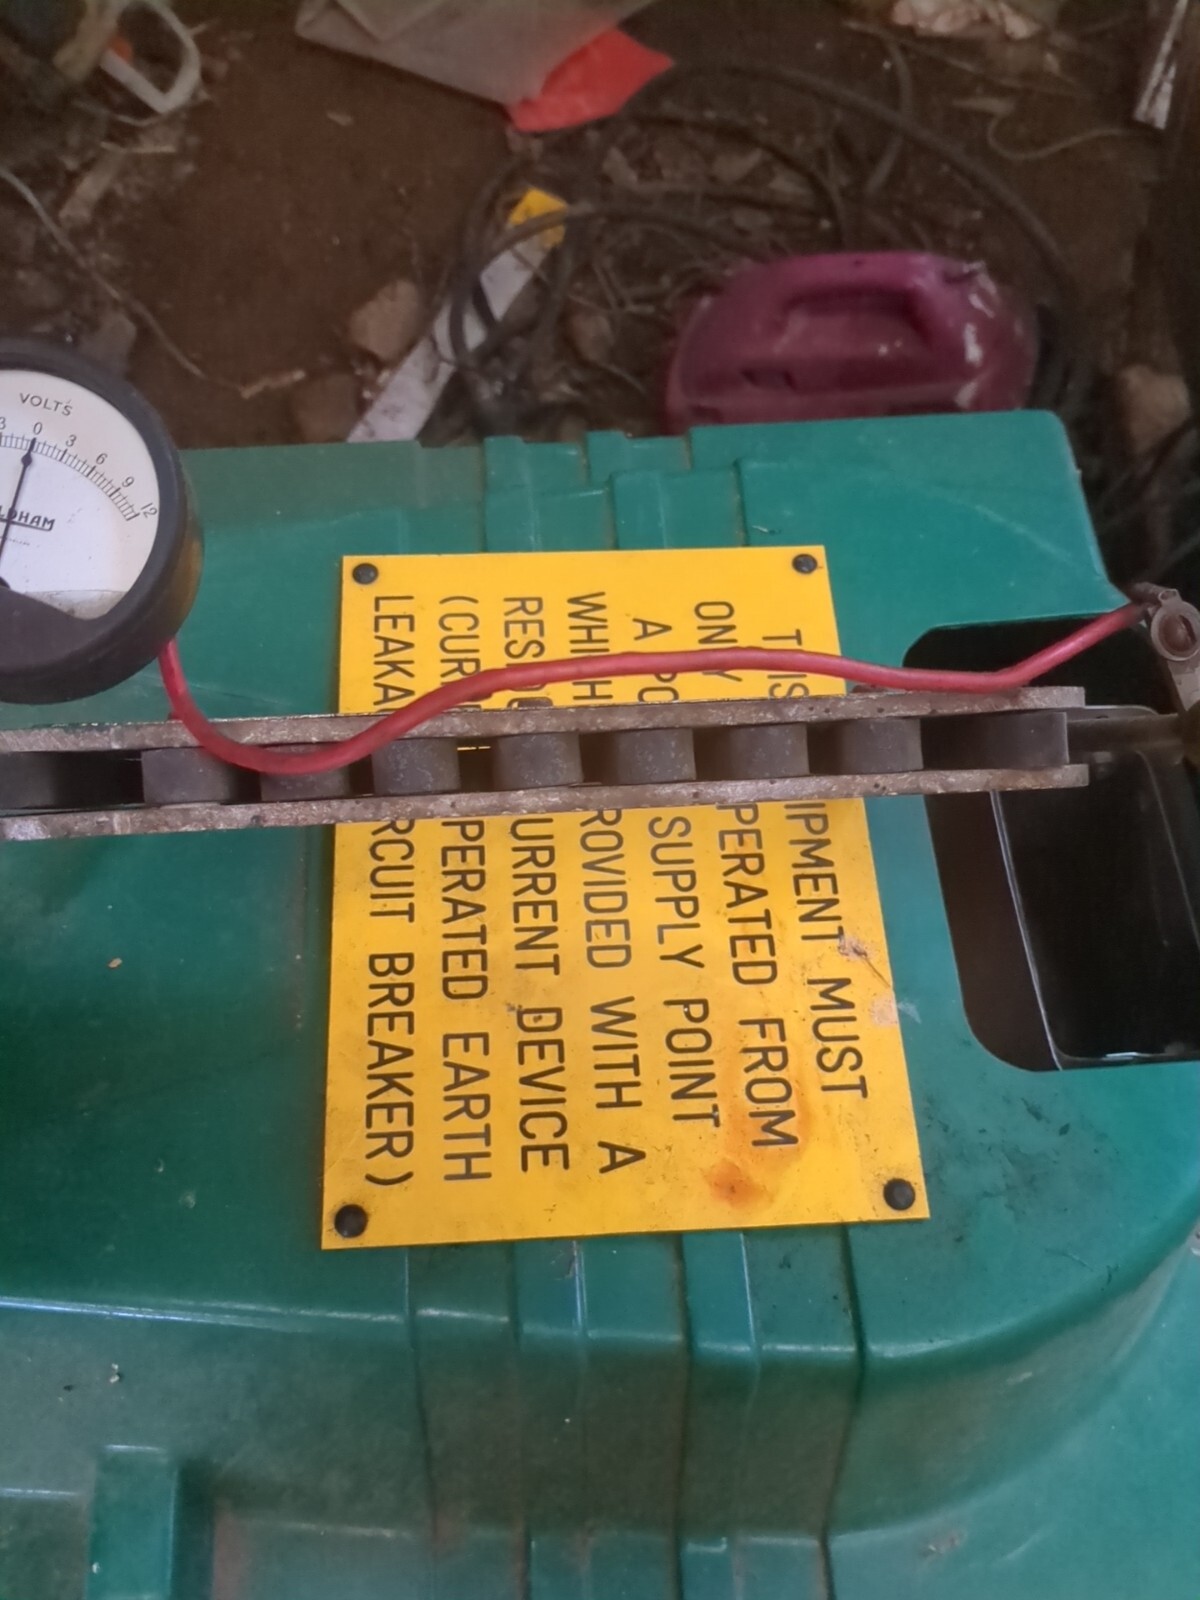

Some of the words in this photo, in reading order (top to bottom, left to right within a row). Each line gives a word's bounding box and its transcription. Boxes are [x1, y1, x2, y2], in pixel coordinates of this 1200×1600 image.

[19, 392, 73, 417] VOLTS
[0, 505, 56, 531] LDHAM
[33, 422, 42, 435] 0
[65, 434, 77, 447] 3
[96, 453, 108, 466] 6
[122, 476, 134, 488] 9
[140, 502, 158, 519] 12
[373, 596, 415, 712] LEAKA
[567, 592, 613, 700] WHIH
[632, 618, 672, 640] A
[694, 601, 743, 682] ONY
[762, 629, 809, 699] TIS
[369, 819, 415, 923] RCUIT
[441, 820, 489, 1001] PERATED
[510, 817, 561, 976] URRENT
[579, 809, 632, 969] ROVIDED
[648, 816, 704, 969] SUPPLY
[716, 803, 778, 985] PERATED
[784, 803, 845, 945] IPMENT
[365, 952, 415, 1187] BREAKER)
[516, 1007, 569, 1173] DEVICE
[589, 996, 643, 1110] WITH
[663, 998, 721, 1128] POINT
[738, 1017, 799, 1148] FROM
[805, 977, 868, 1099] MUST
[442, 1032, 493, 1182] EARTH
[599, 1140, 647, 1174] A
